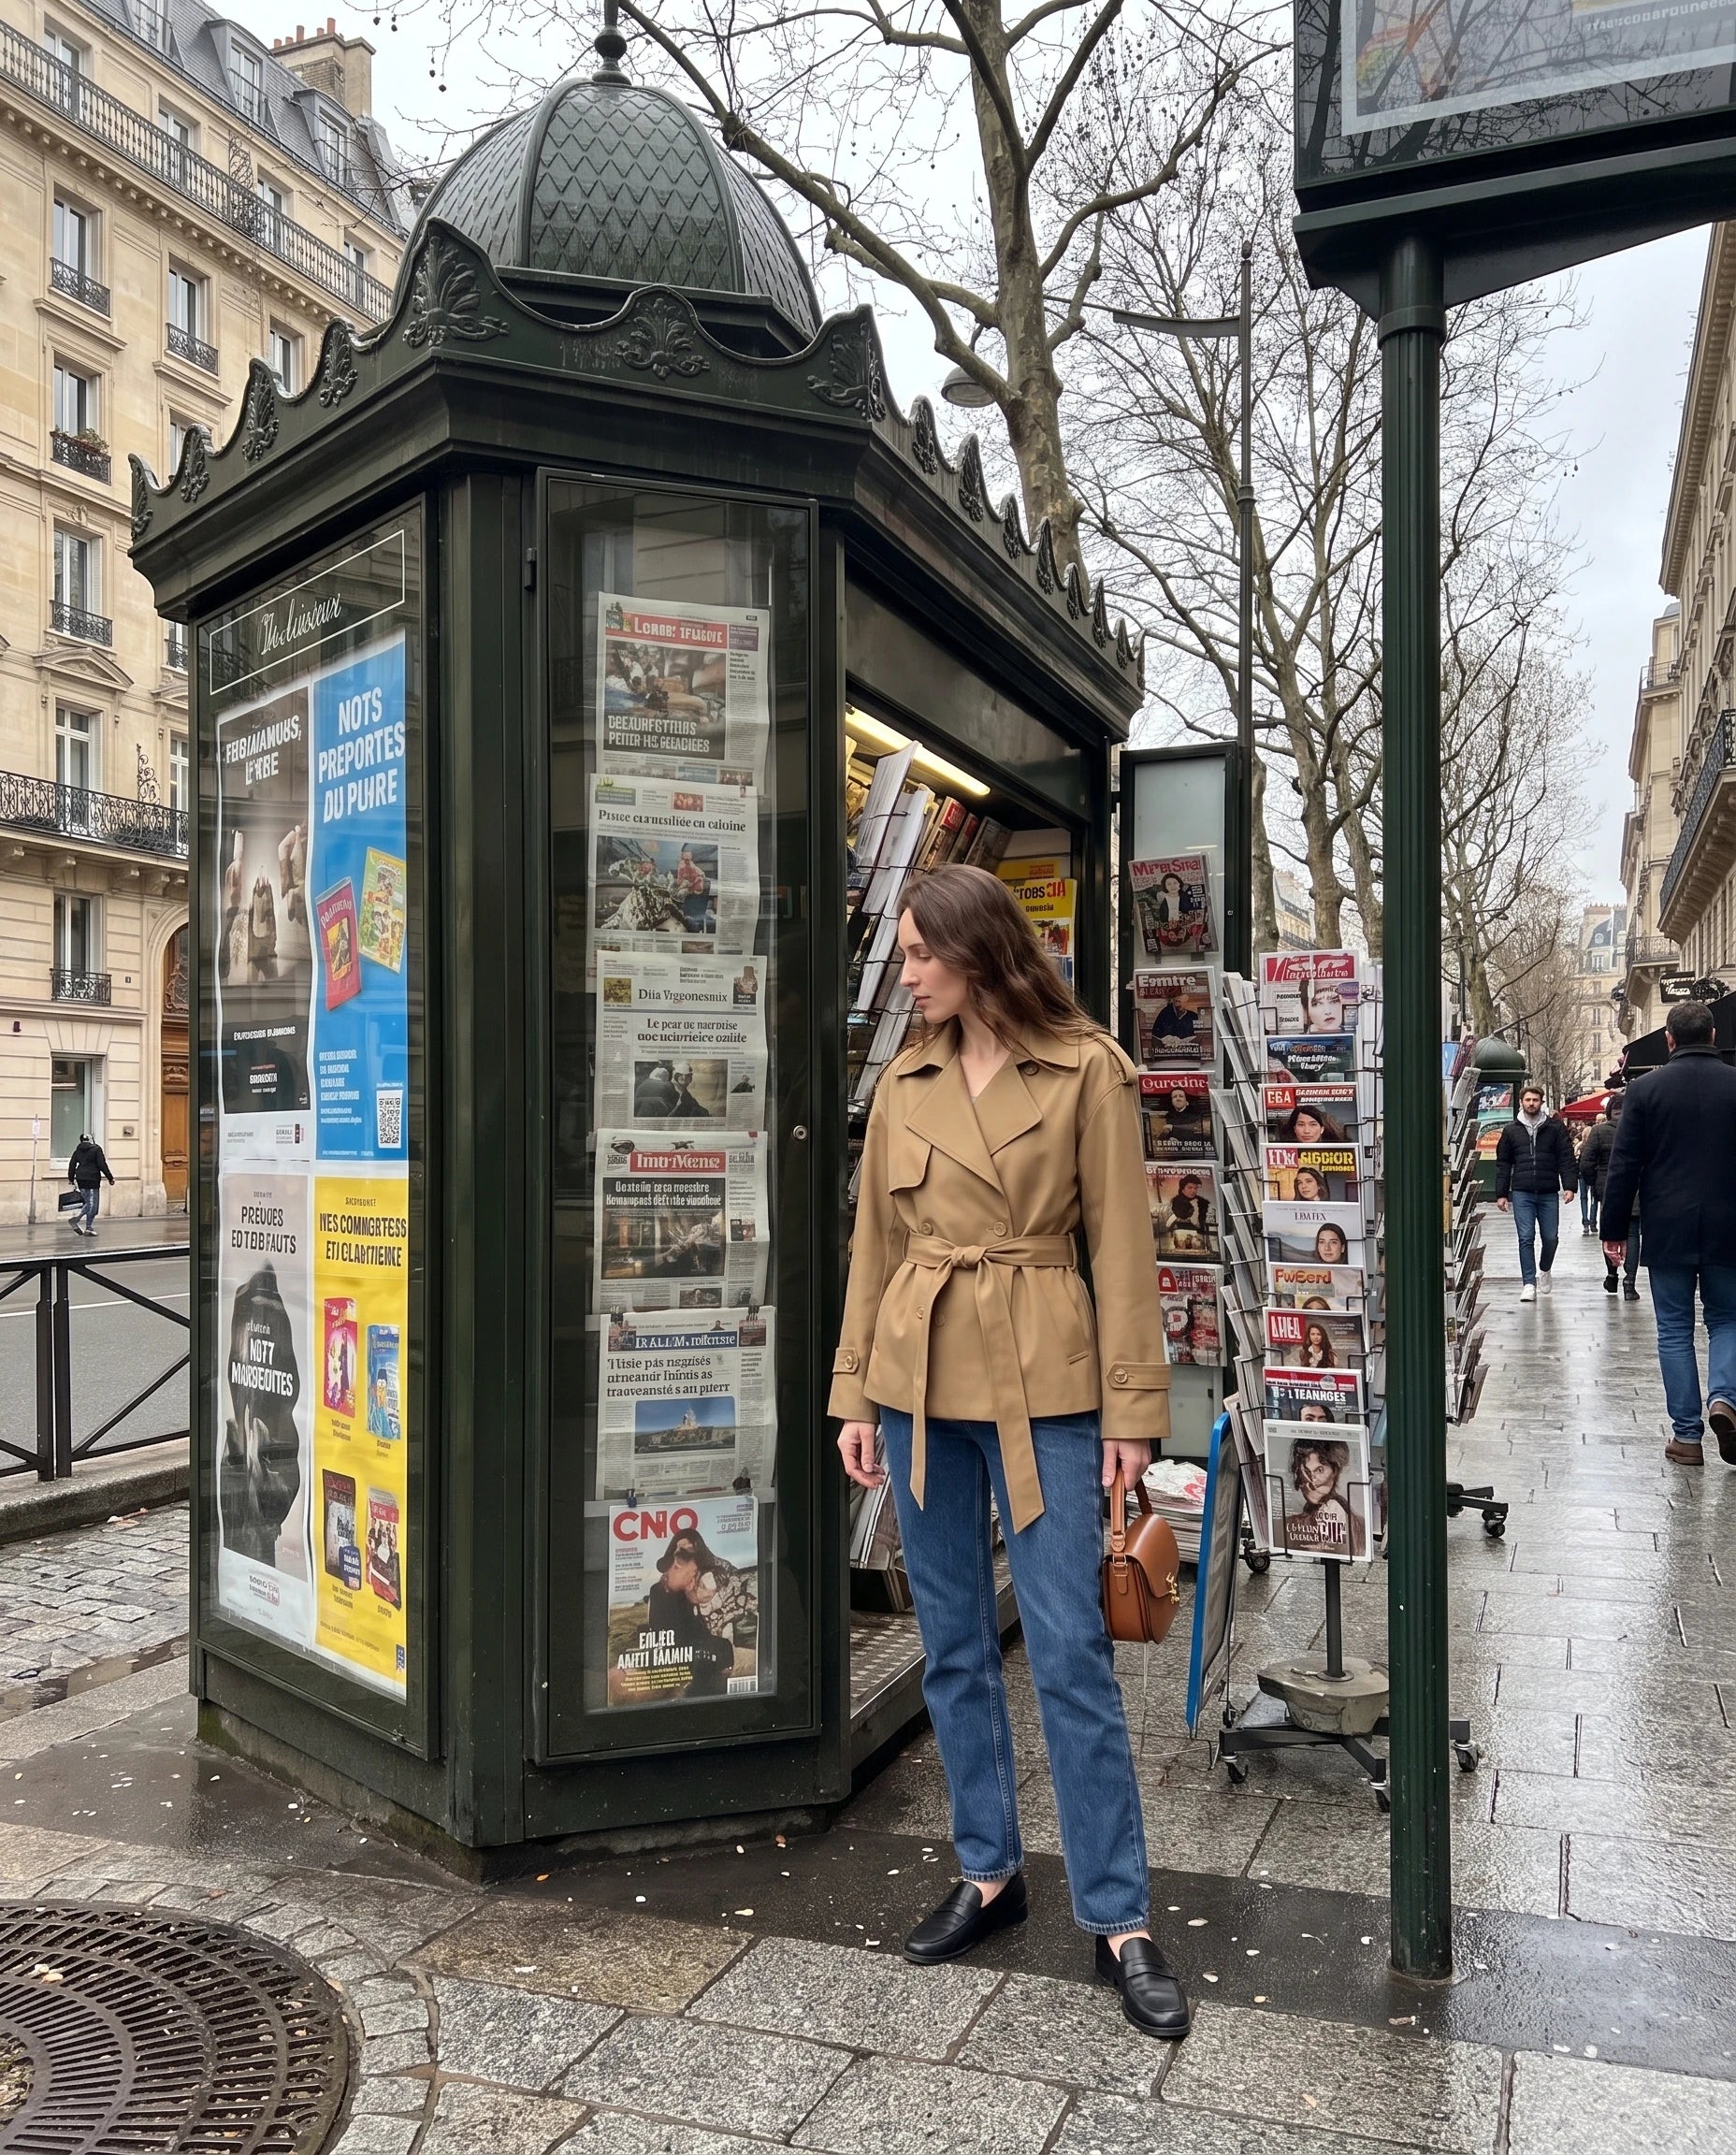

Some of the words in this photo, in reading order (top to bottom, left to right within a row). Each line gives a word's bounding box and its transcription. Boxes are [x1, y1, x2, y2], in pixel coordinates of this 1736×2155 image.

[339, 687, 383, 735] NOTS
[318, 721, 406, 784] PREPORTES
[323, 786, 344, 824] DU
